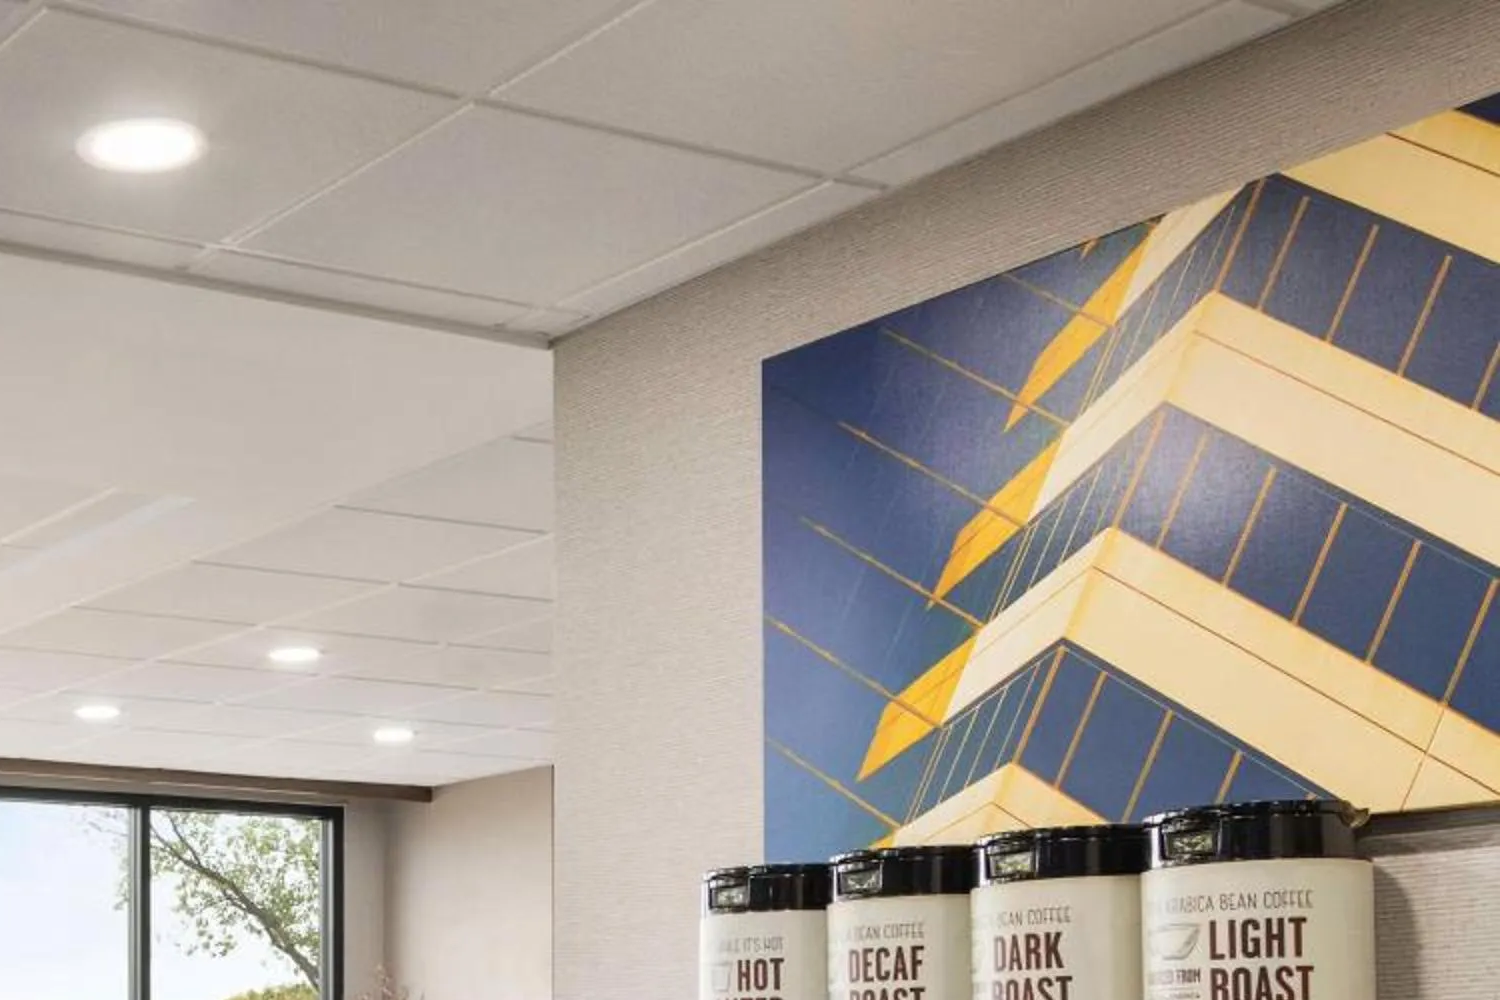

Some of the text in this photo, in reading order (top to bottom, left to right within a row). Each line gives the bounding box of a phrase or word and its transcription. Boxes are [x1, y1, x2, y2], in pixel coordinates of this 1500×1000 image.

[1219, 891, 1257, 911] BEAN
[1263, 889, 1314, 909] COFFEE
[1027, 905, 1072, 925] COFFEE
[763, 936, 784, 952] HOT
[883, 921, 925, 939] COFFEE
[1208, 917, 1307, 961] LIGHT
[848, 945, 925, 983] DECAF
[993, 931, 1065, 972] DARK
[737, 957, 785, 992] HOT
